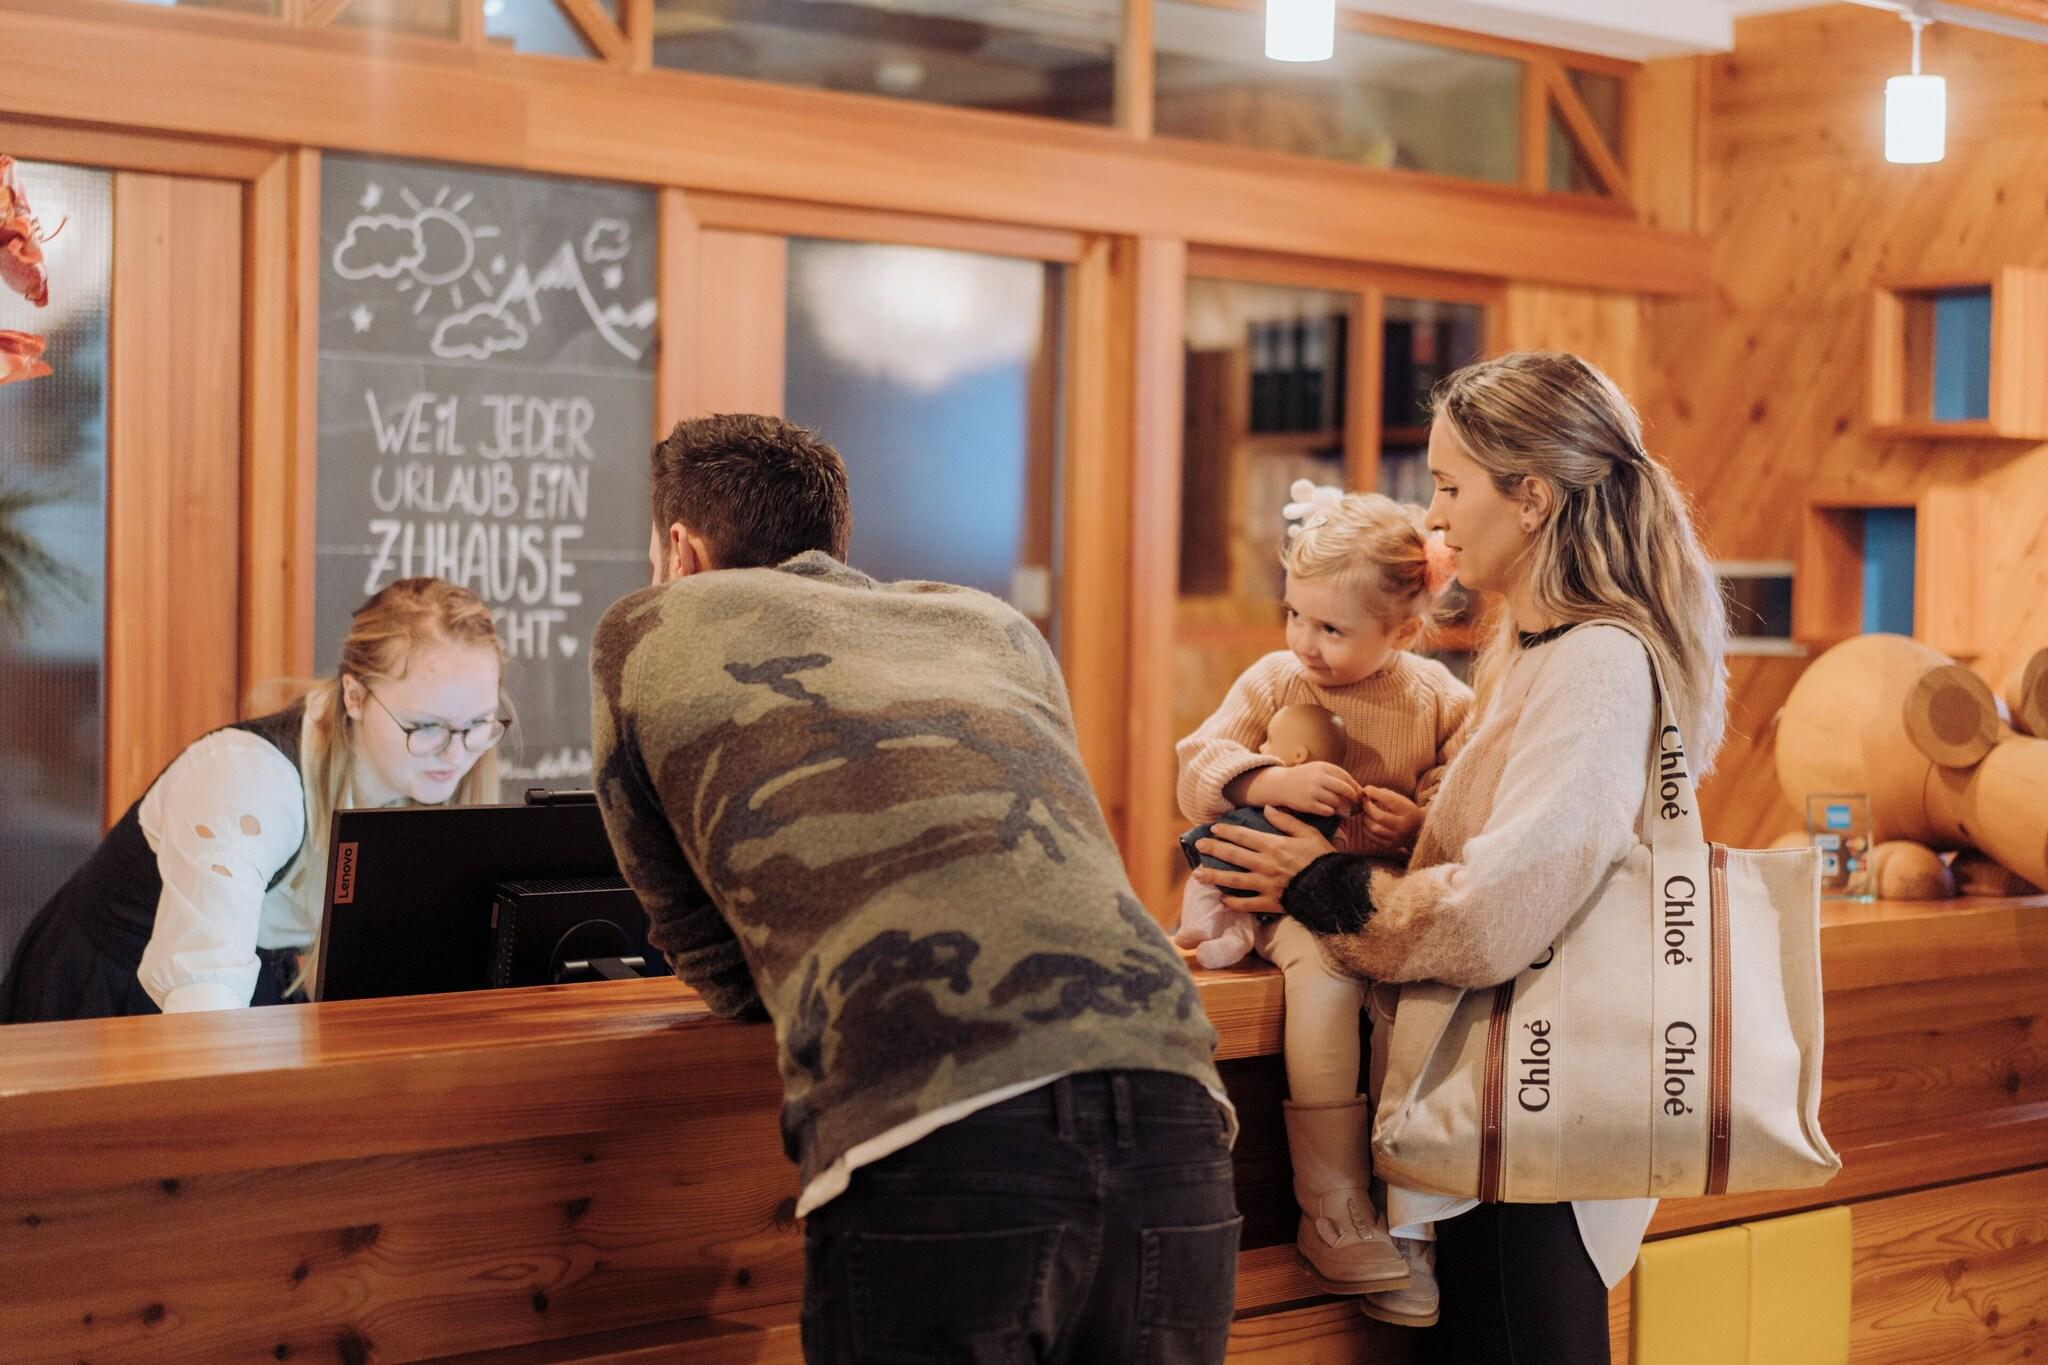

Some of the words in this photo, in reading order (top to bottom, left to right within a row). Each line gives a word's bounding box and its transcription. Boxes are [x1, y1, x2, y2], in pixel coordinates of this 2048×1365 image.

[477, 393, 597, 460] JEDER
[370, 461, 519, 517] URLAUB
[364, 518, 584, 606] ZUHAUSE
[1660, 725, 1688, 820] Chloé
[338, 847, 353, 899] Lenovo
[1663, 875, 1696, 966] Chloé
[1518, 1019, 1551, 1112] Chloé
[1663, 1020, 1697, 1117] Chloé
